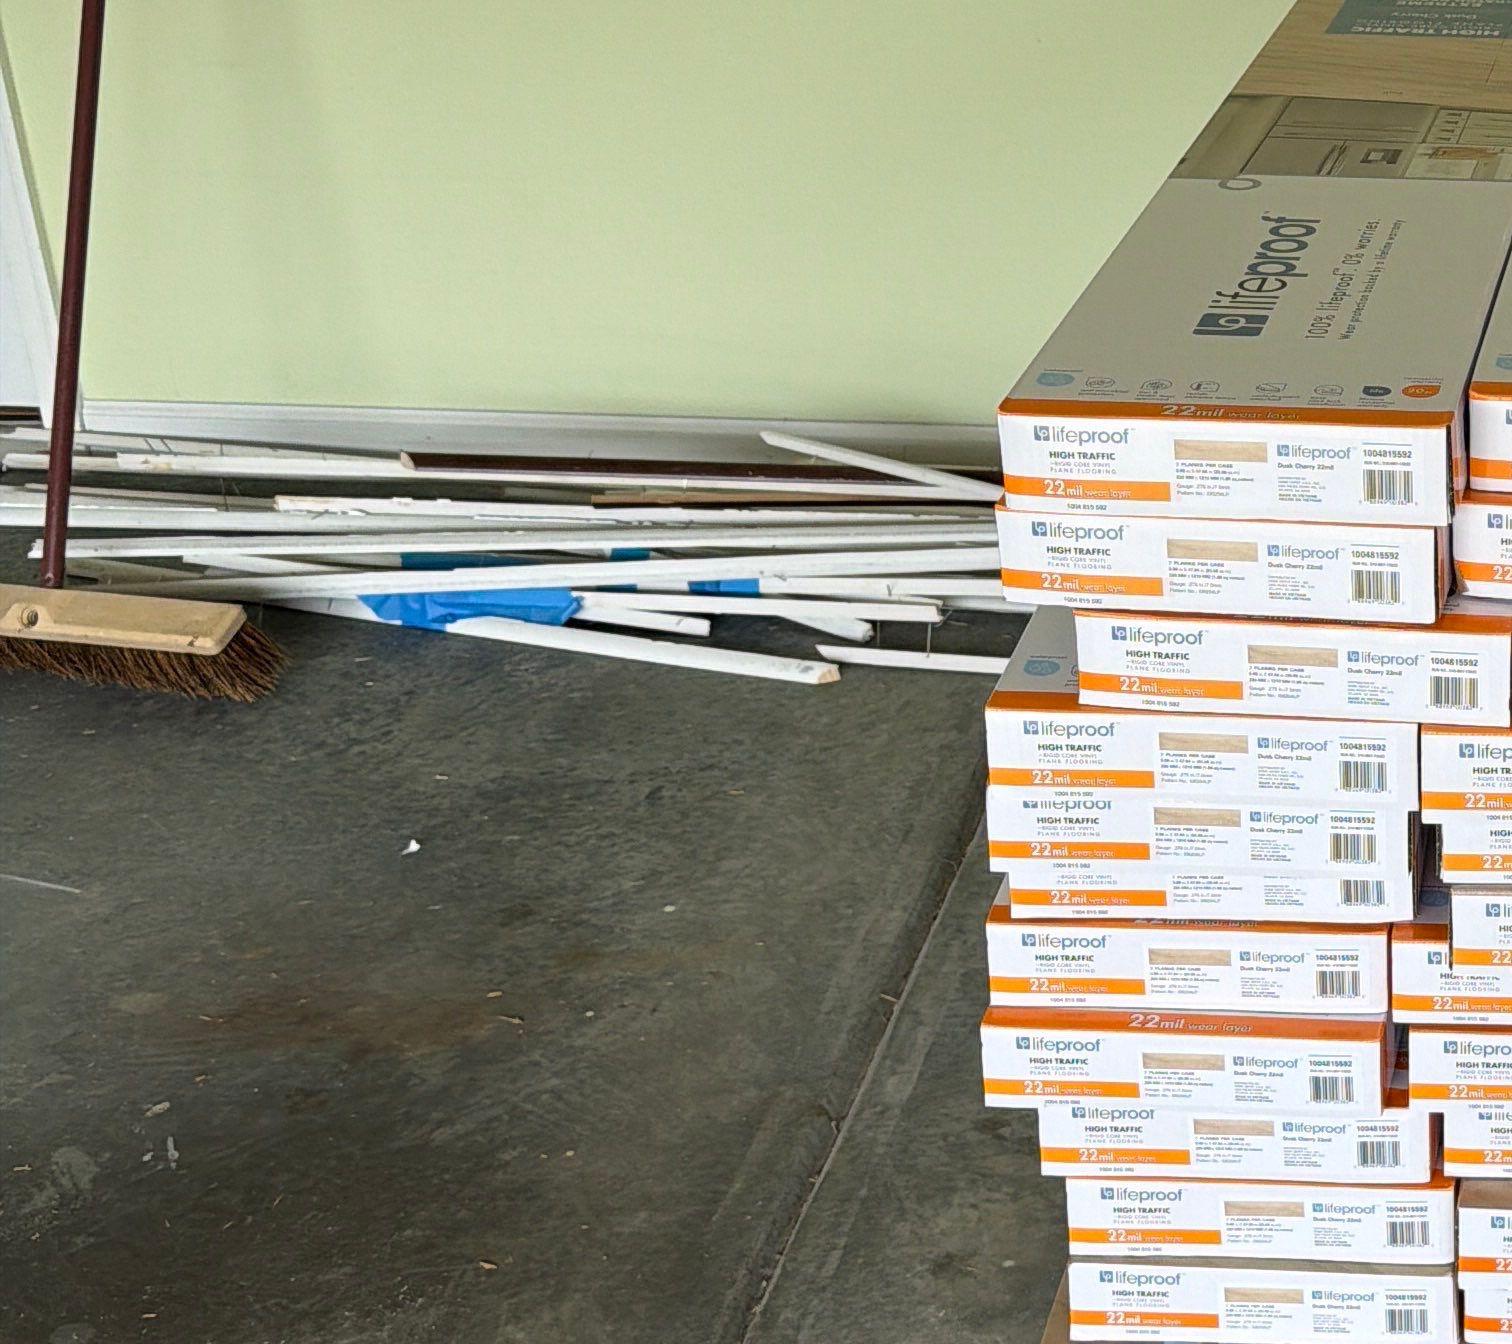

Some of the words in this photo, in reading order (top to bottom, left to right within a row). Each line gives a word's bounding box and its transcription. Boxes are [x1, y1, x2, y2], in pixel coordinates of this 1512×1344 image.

[1208, 214, 1321, 311] lifeproof
[1304, 315, 1336, 339] 100%
[1341, 252, 1366, 266] 0%
[1052, 426, 1128, 447] lifeproof
[1049, 450, 1074, 460] HIGH
[1078, 451, 1115, 460] TRAFFIC
[1291, 445, 1351, 461] lifeproof
[1050, 522, 1124, 542] lifeproof
[1046, 546, 1071, 555] HIGH
[1074, 546, 1110, 556] TRAFFIC
[1282, 546, 1340, 561] lifeproof
[1129, 627, 1203, 647] lifeproof
[1125, 650, 1150, 660] HIGH
[1153, 651, 1189, 660] TRAFFIC
[1361, 652, 1419, 667] lifeproof
[1041, 721, 1115, 739] lifeproof
[1038, 934, 1107, 951] lifeproof
[1033, 1037, 1102, 1054] lifeproof
[1089, 1106, 1155, 1122] lifeproof
[1117, 1187, 1183, 1203] lifeproof
[1115, 1272, 1180, 1287] lifeproof
